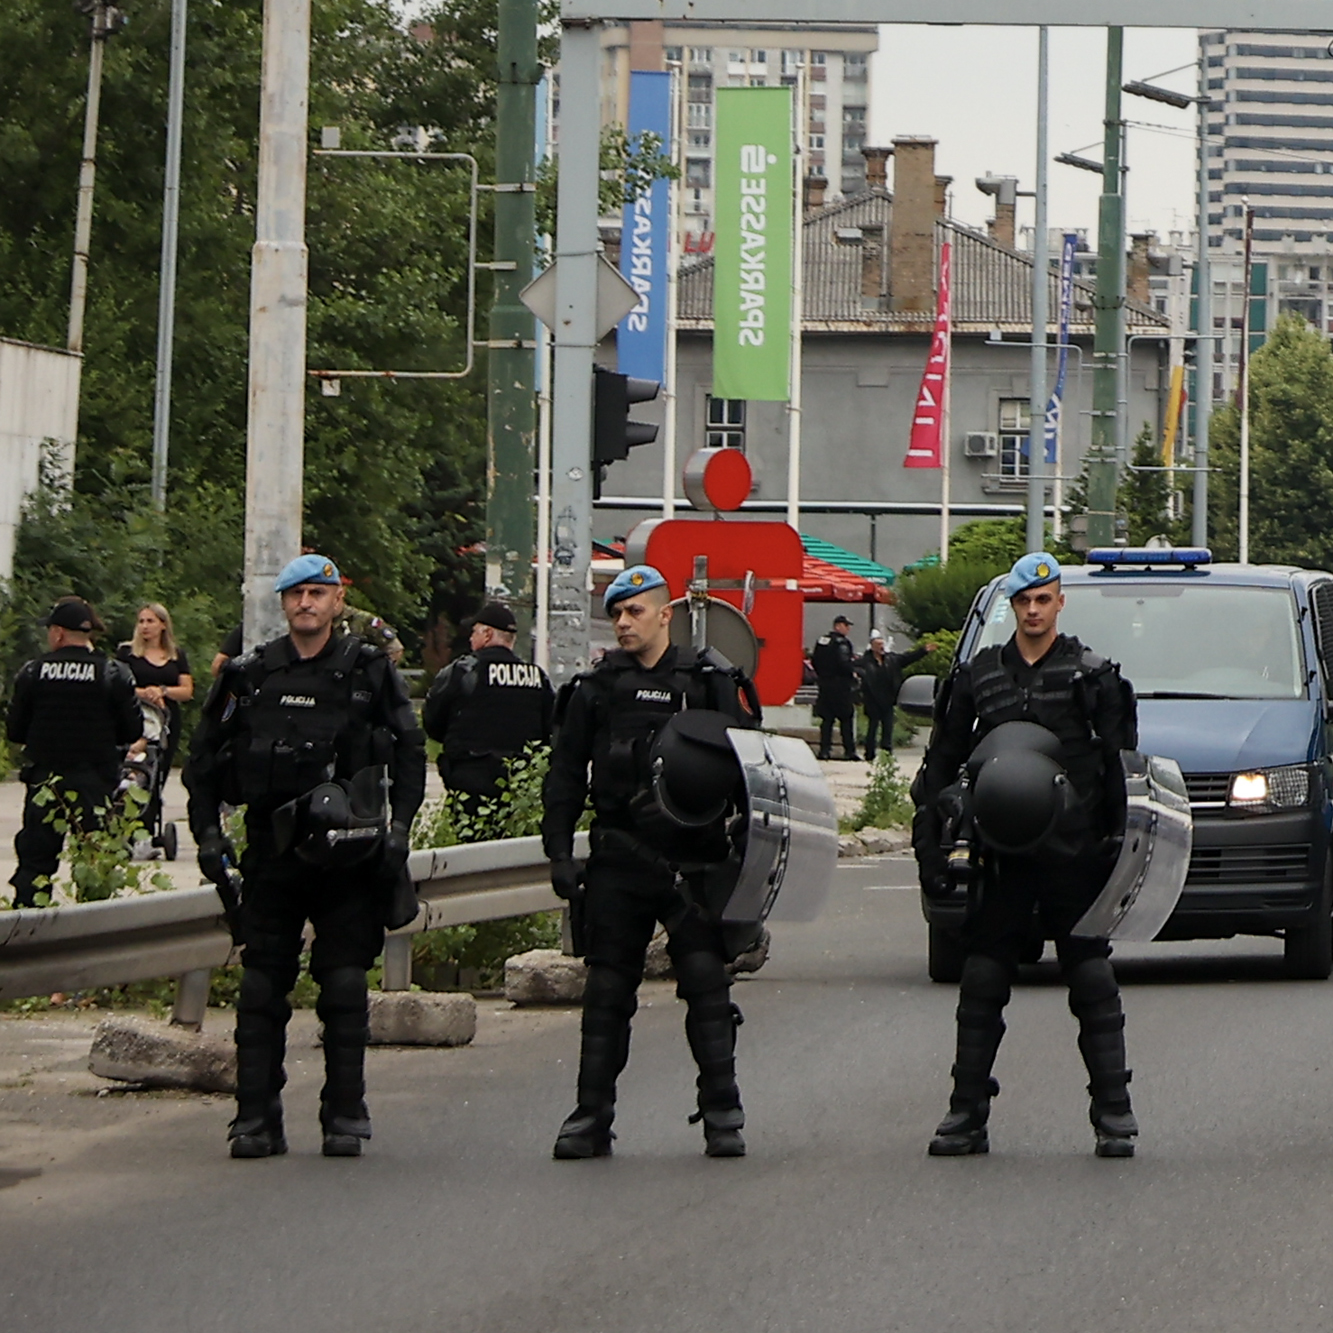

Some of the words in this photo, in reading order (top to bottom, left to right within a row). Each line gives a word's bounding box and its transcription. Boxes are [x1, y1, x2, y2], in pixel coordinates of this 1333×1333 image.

[40, 662, 95, 682] POLICIJA
[488, 663, 542, 688] POLICIJA
[280, 695, 316, 706] POLICIJA
[636, 689, 671, 702] POLICIJA
